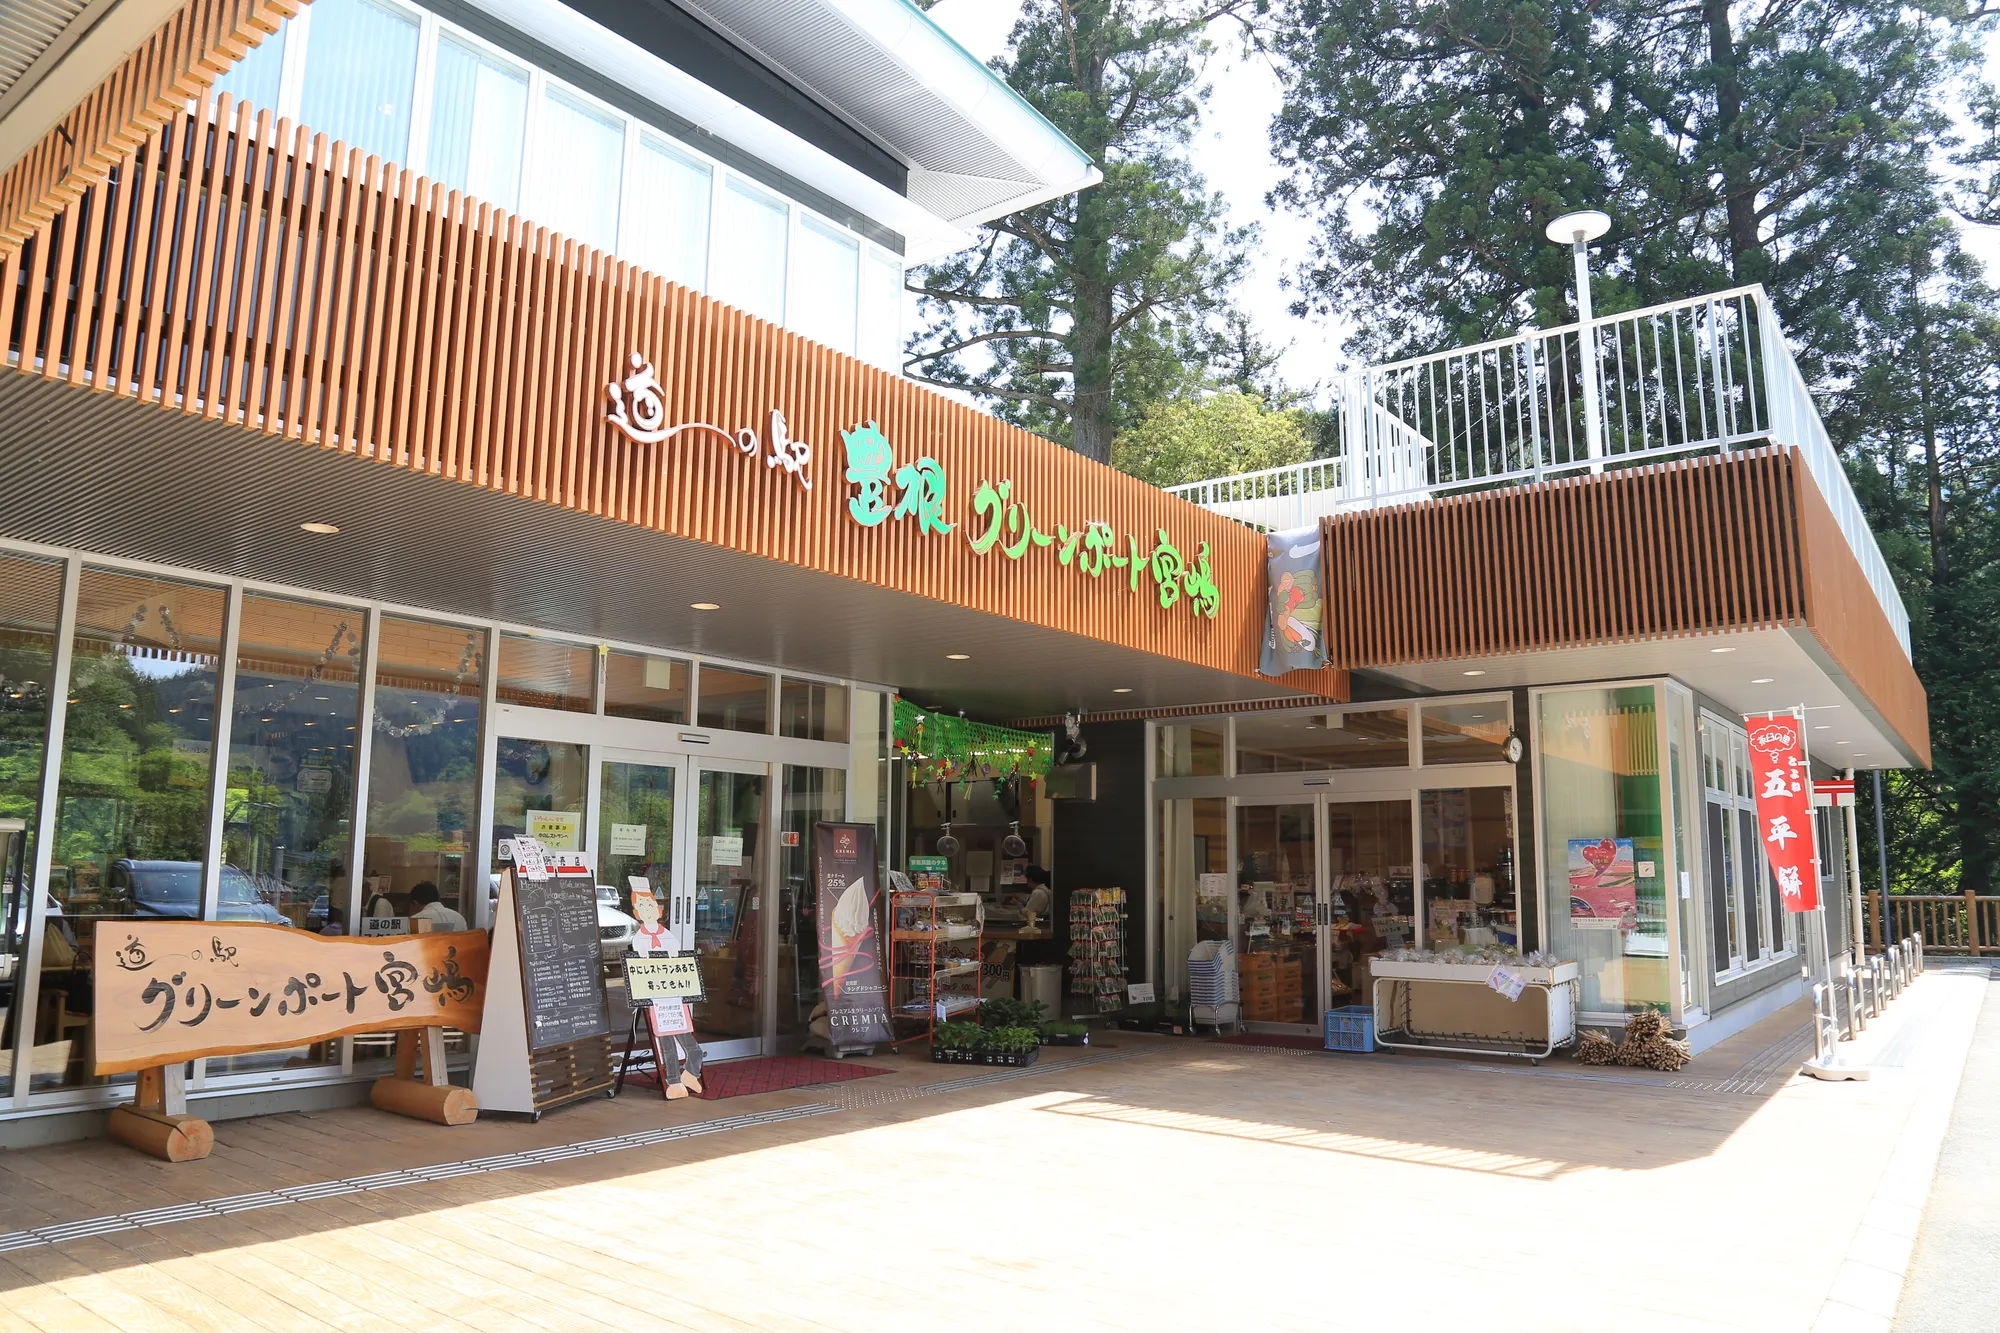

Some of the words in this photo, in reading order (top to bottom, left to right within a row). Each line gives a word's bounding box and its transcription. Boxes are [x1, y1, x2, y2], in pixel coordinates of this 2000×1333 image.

[603, 352, 813, 491] 道の駅
[1761, 768, 1803, 899] 五平餅
[827, 879, 845, 887] 25%
[369, 919, 401, 930] 道の駅
[115, 934, 239, 972] 道の駅
[629, 963, 695, 975] 中にレストランあるで
[830, 1013, 889, 1027] CREMIA
